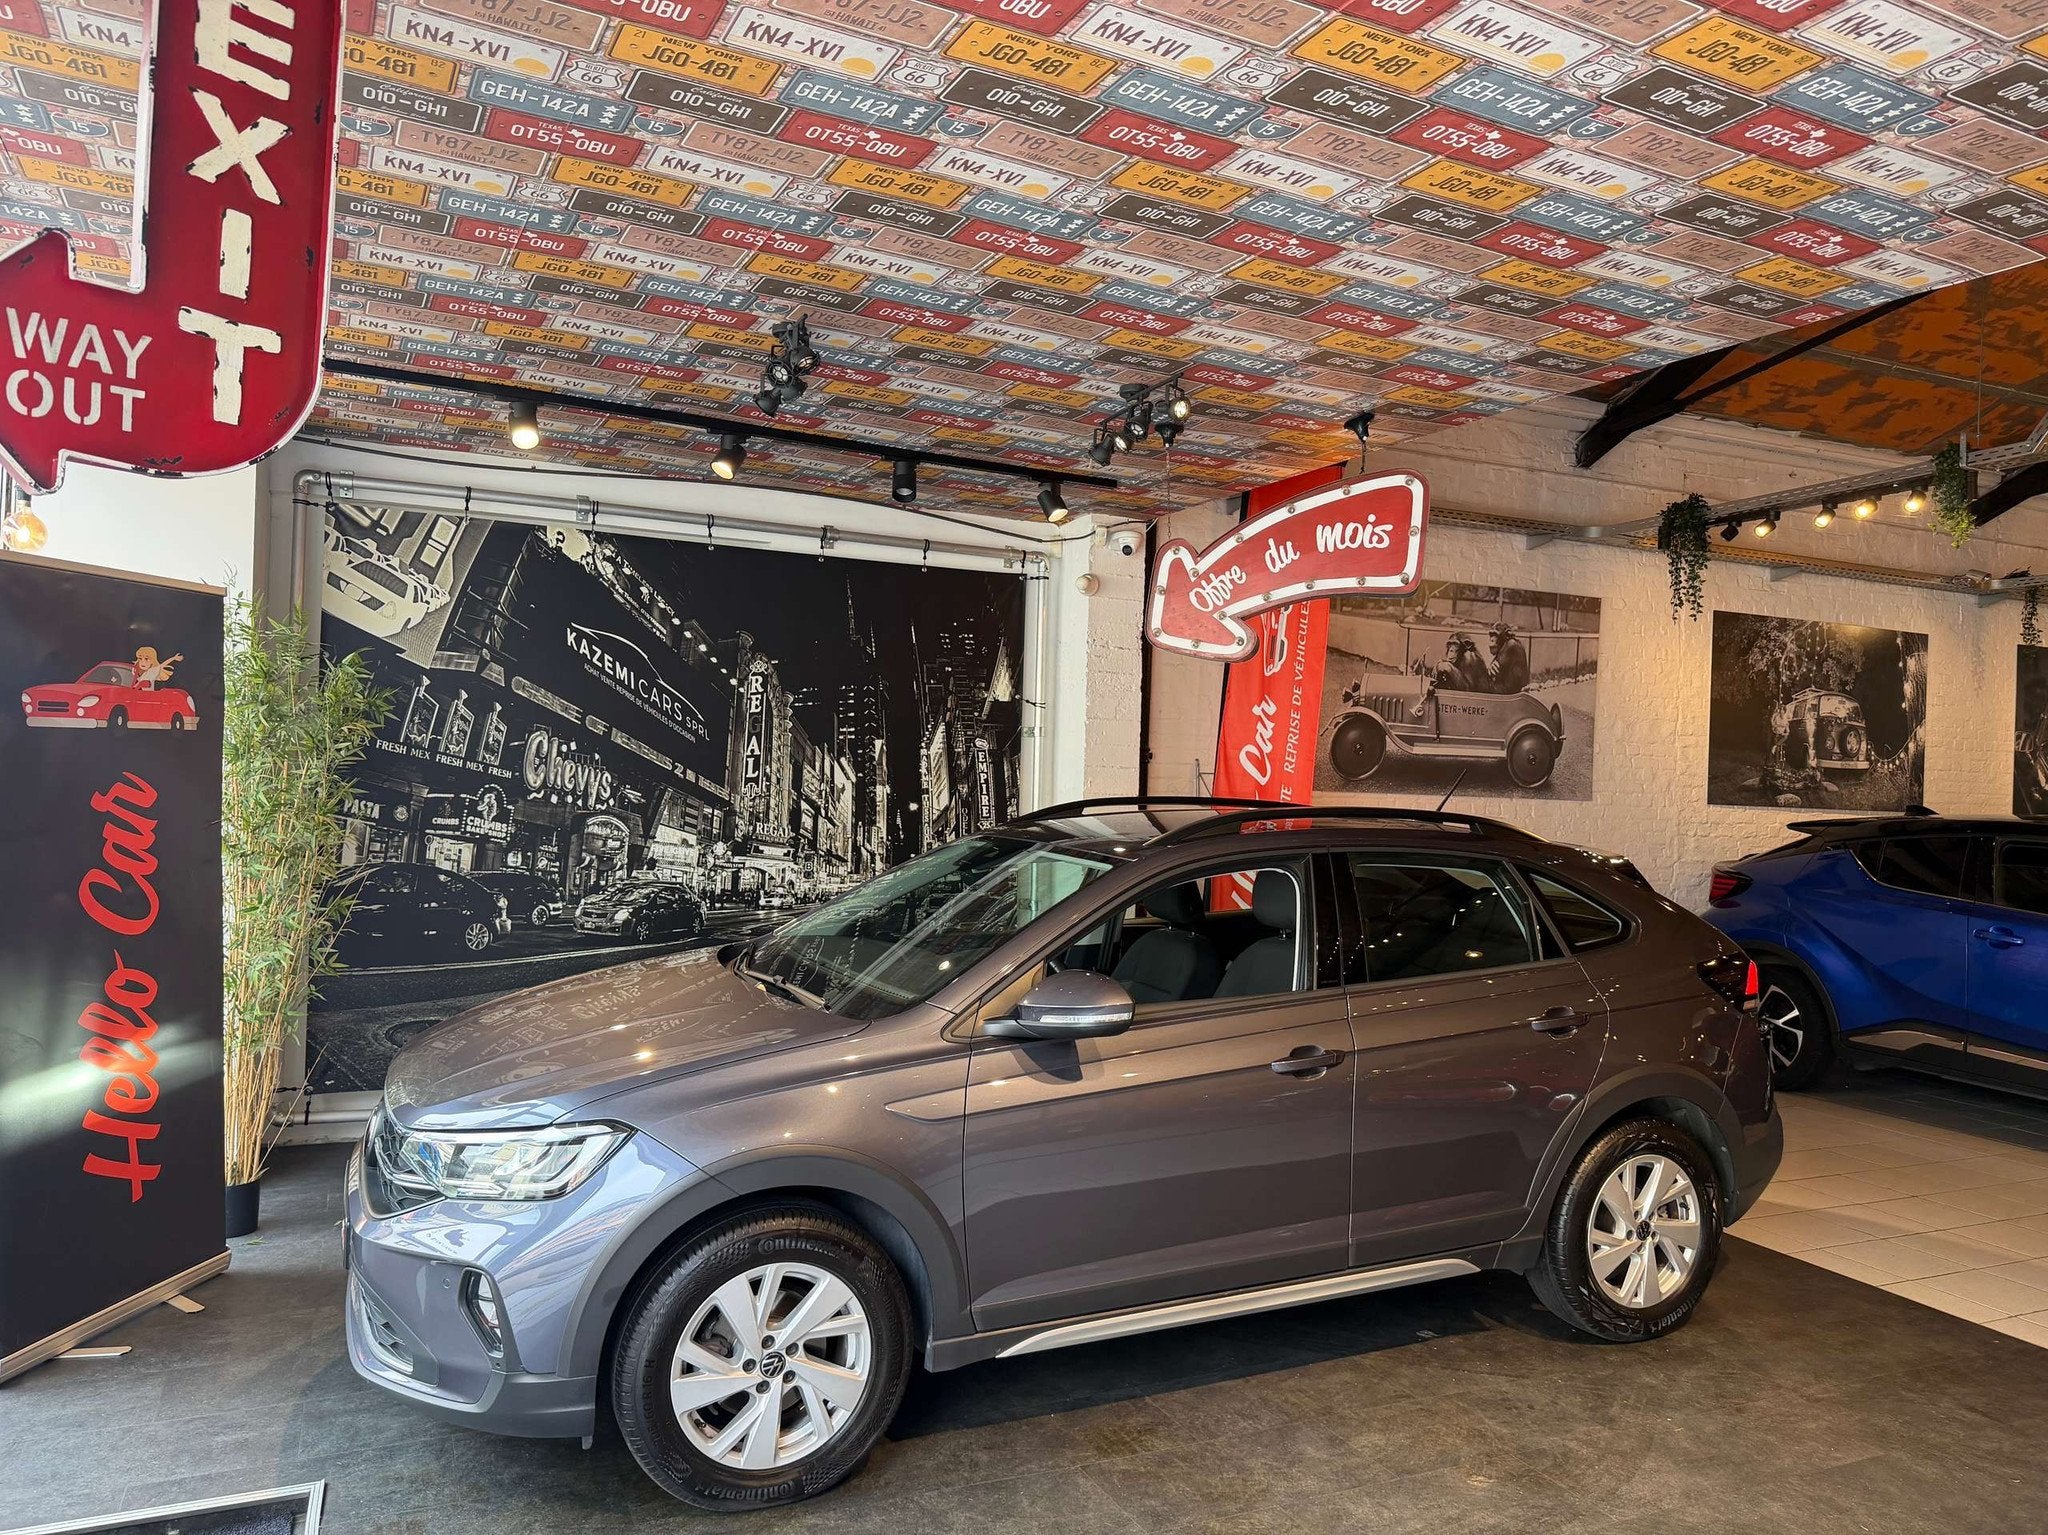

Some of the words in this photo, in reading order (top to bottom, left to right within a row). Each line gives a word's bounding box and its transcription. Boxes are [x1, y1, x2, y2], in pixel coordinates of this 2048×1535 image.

[662, 37, 697, 49] NEW
[705, 46, 745, 61] YORK
[1005, 34, 1040, 46] NEW
[1044, 44, 1084, 59] YORK
[1361, 32, 1396, 44] NEW
[1396, 42, 1434, 58] YORK
[1729, 30, 1764, 43] NEW
[1759, 40, 1797, 56] YORK
[582, 72, 602, 84] 66
[904, 71, 927, 83] 66
[1238, 71, 1263, 83] 66
[1583, 69, 1611, 81] 66
[1938, 64, 1970, 77] 66
[354, 120, 371, 131] 15
[648, 121, 665, 132] 15
[948, 121, 968, 133] 15
[1257, 123, 1281, 135] 15
[1576, 122, 1604, 134] 15
[178, 0, 296, 425] EXIT
[6, 307, 152, 380] WAY
[6, 369, 146, 432] OUT
[1264, 537, 1300, 574] du
[1315, 513, 1393, 553] mois
[566, 627, 635, 690] KAZEMI
[638, 678, 683, 721] CARS
[685, 716, 710, 741] SPRL
[1438, 703, 1485, 716] TEYR-WERKE
[1283, 708, 1301, 774] REPRISE
[1292, 686, 1302, 706] DE
[376, 739, 407, 754] FRESH
[410, 748, 431, 760] MEX
[435, 753, 463, 768] FRESH
[466, 760, 485, 773] MEX
[488, 766, 512, 779] FRESH
[523, 730, 612, 811] Chevys
[978, 751, 990, 817] EMPIRE
[467, 816, 508, 834] CRUMBS
[78, 771, 160, 936] Car
[78, 949, 161, 1204] Hello
